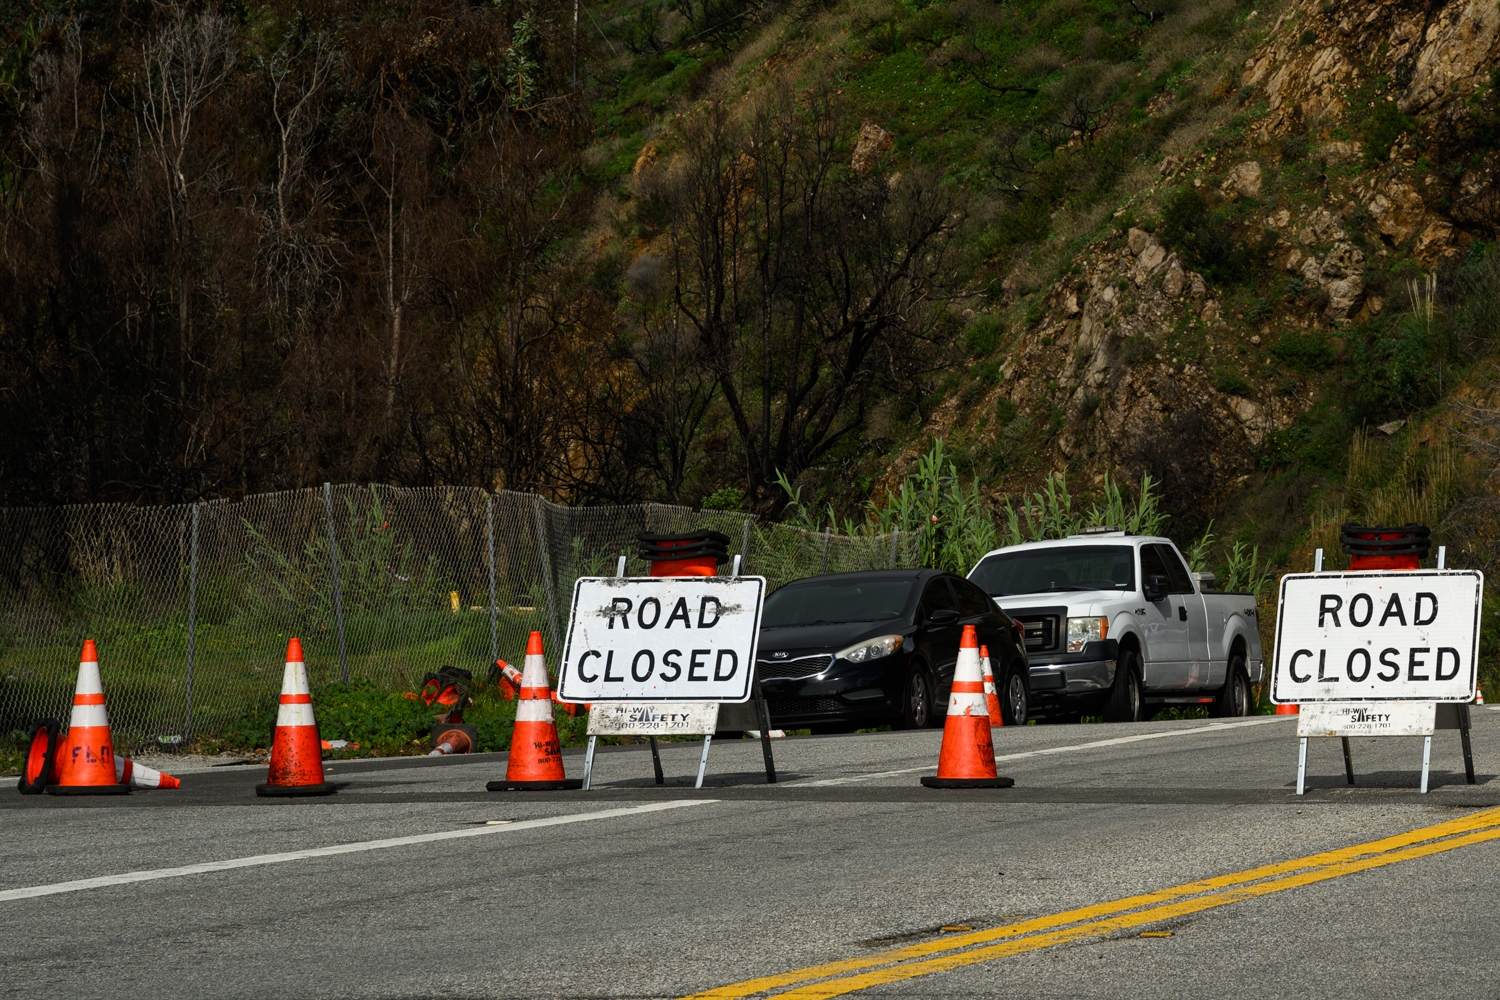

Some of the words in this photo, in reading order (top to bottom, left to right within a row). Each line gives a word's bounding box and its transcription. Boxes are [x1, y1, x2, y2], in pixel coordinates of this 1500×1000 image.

[608, 597, 722, 629] ROAD
[1318, 592, 1439, 627] ROAD
[577, 649, 738, 683] CLOSED
[1289, 647, 1460, 683] CLOSED
[629, 713, 690, 722] SAFETY
[1351, 713, 1391, 722] SAFETY
